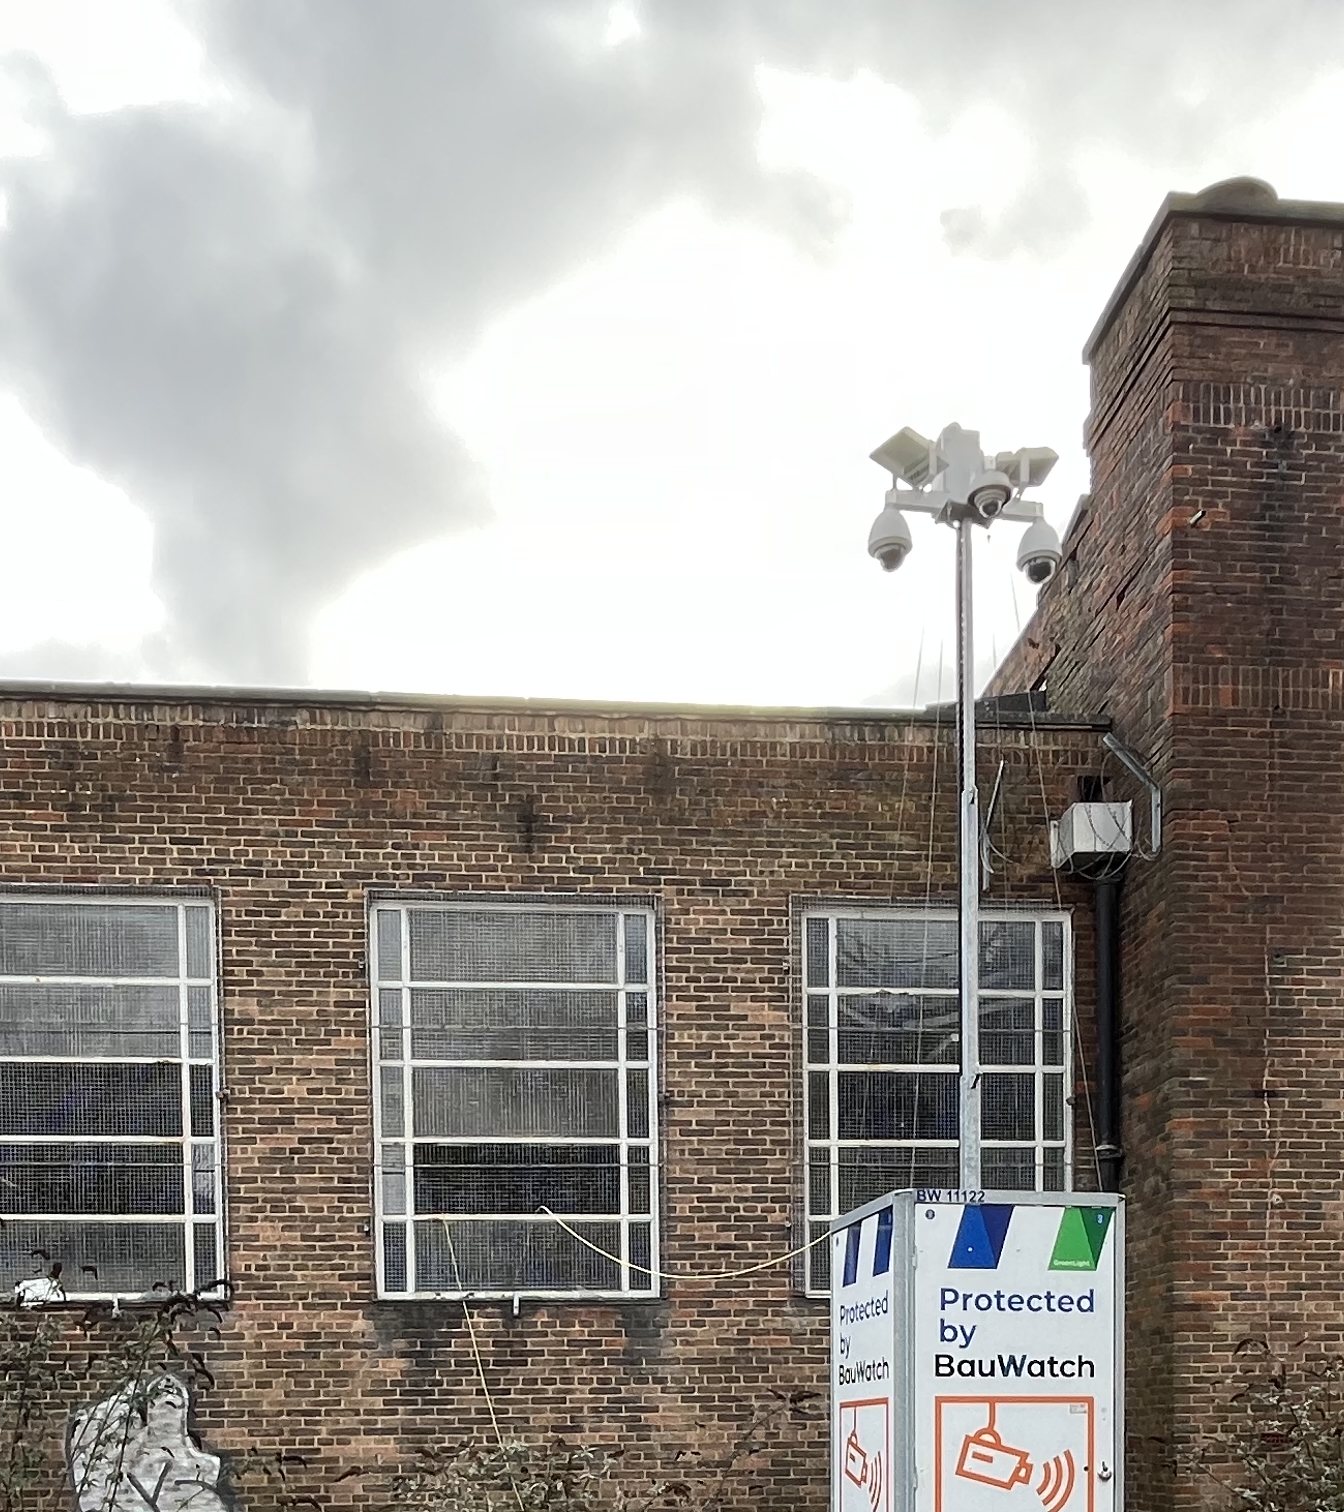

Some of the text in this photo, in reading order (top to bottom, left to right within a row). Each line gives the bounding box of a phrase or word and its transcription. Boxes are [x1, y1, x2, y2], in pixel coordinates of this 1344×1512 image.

[917, 1190, 985, 1203] BW 11122
[840, 1289, 888, 1326] Protected
[940, 1287, 1095, 1313] Protected
[840, 1332, 851, 1359] by
[939, 1318, 977, 1349] by
[838, 1357, 889, 1386] BauWatch
[934, 1353, 1095, 1378] BauWatch
